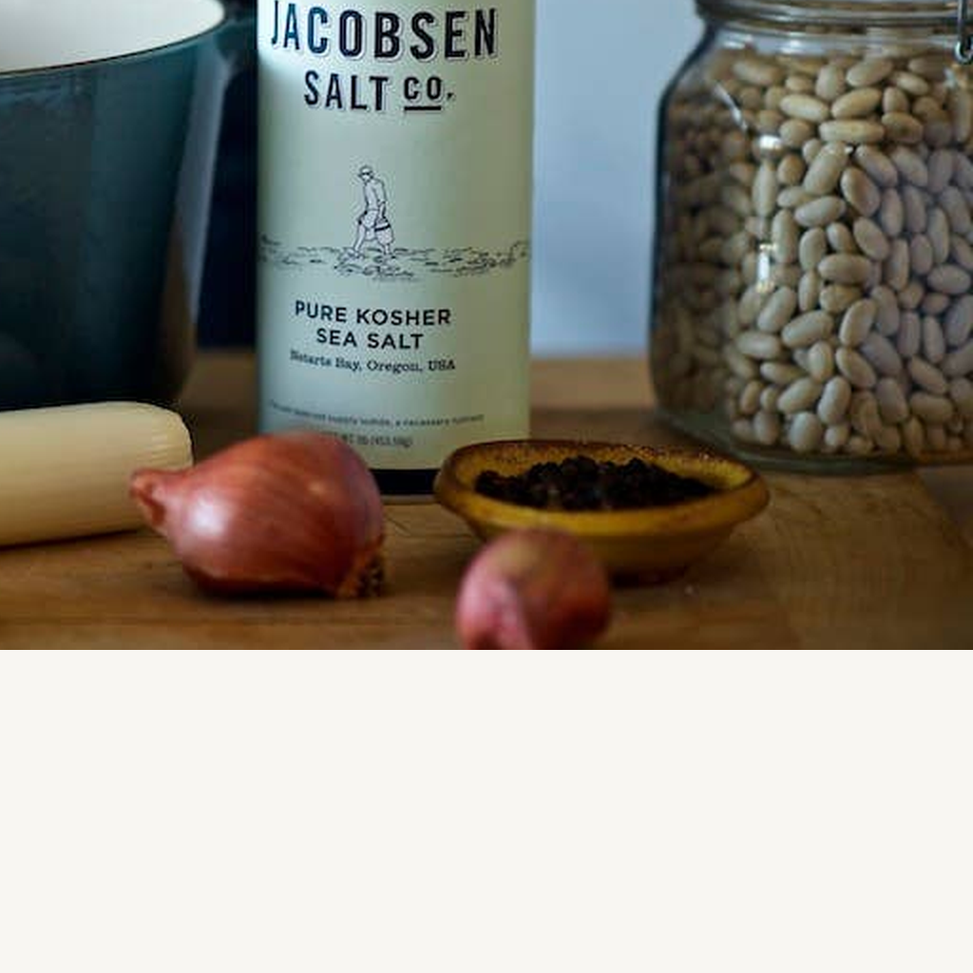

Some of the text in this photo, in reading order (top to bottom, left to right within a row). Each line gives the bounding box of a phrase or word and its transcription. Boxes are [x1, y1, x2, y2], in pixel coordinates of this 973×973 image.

[271, 0, 497, 60] JACOBSEN
[304, 70, 388, 111] SALT
[295, 300, 451, 326] PURE KOSHER
[316, 328, 423, 349] SEA SALT
[335, 357, 363, 372] Bay,
[367, 360, 423, 374] Oregon,
[428, 359, 456, 371] USA
